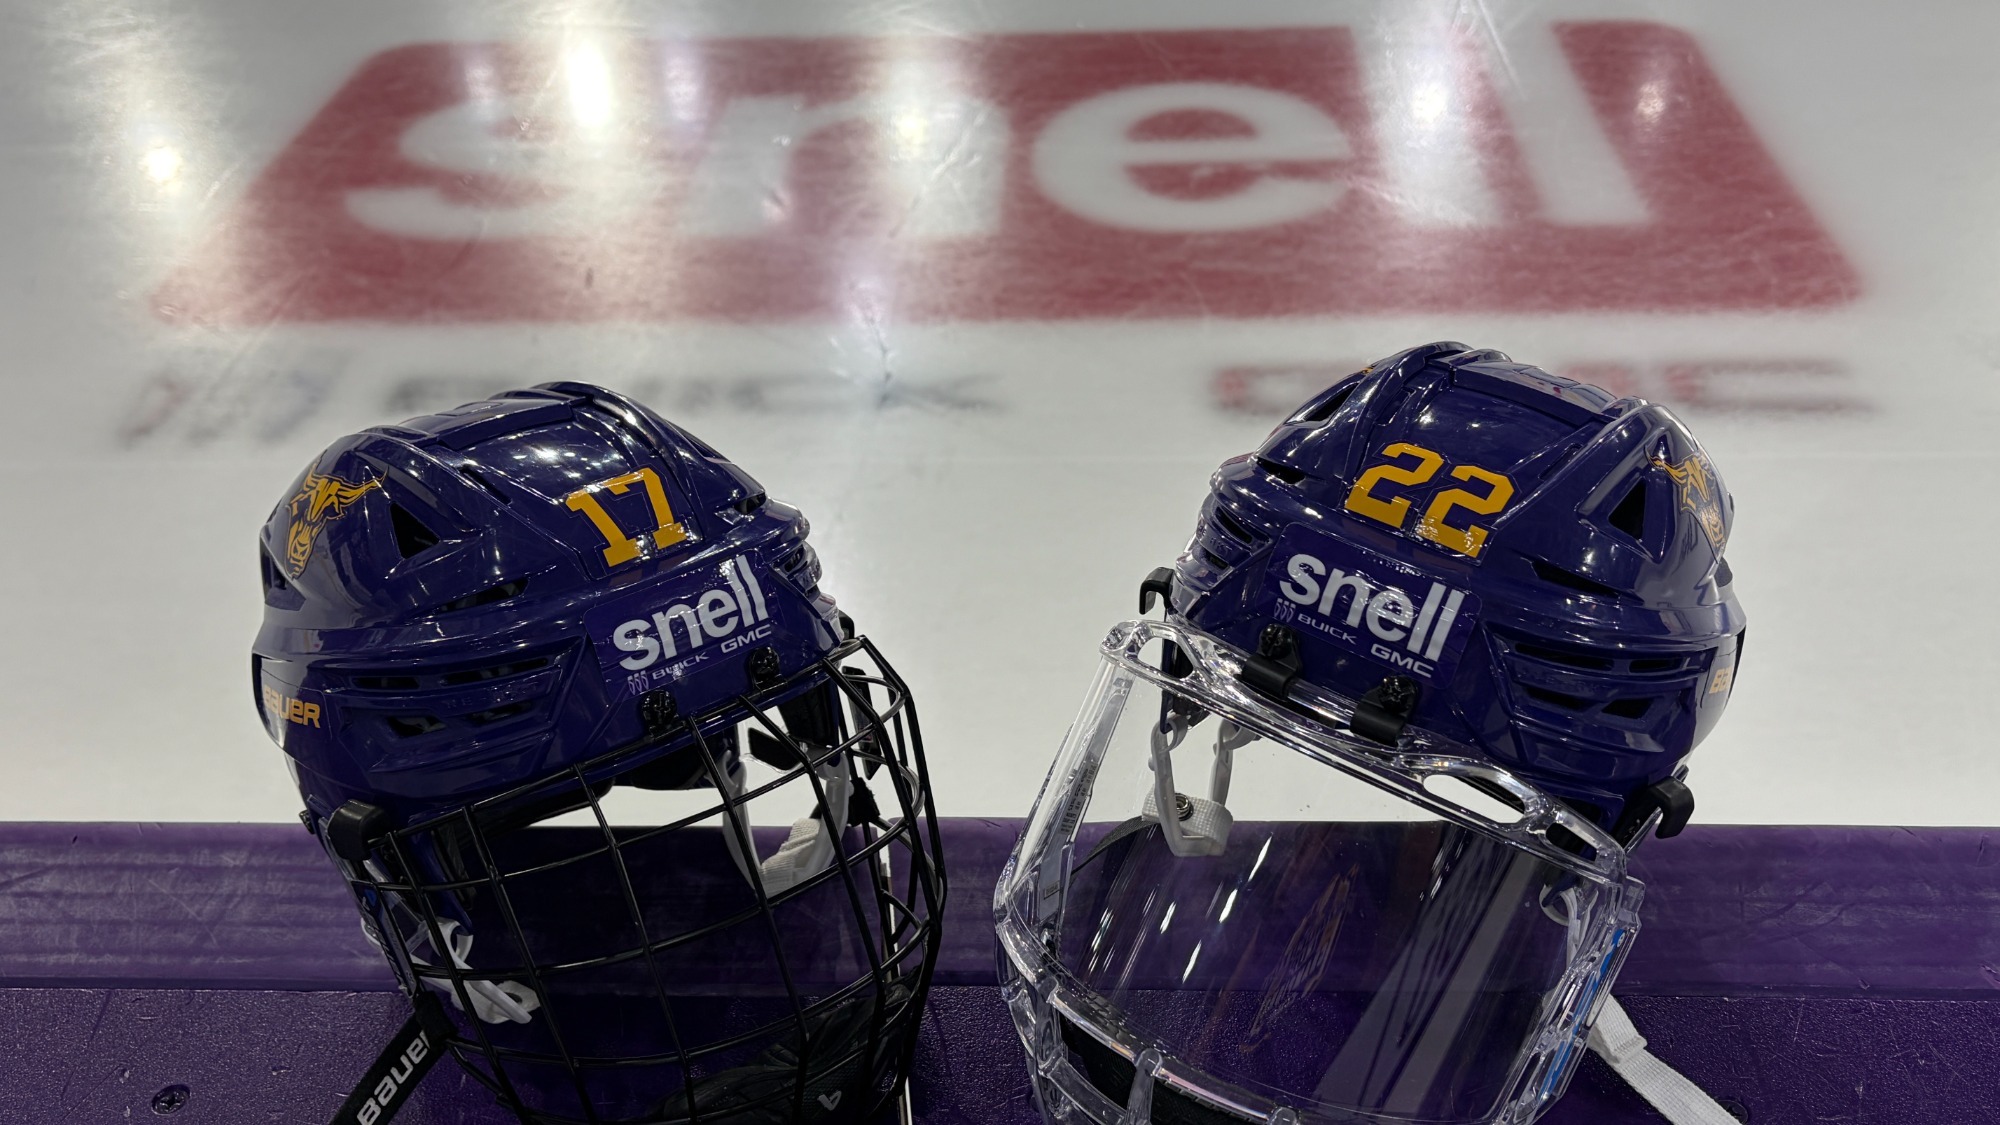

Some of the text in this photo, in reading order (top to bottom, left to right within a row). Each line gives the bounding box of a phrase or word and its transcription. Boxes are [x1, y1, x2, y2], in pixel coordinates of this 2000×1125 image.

[345, 18, 1652, 240] snell
[566, 467, 687, 568] 17
[1344, 442, 1515, 559] 22
[613, 553, 770, 671] snell
[651, 624, 772, 681] BUICK GMC
[1279, 553, 1466, 663] snell
[1298, 613, 1435, 679] BUICK GMC
